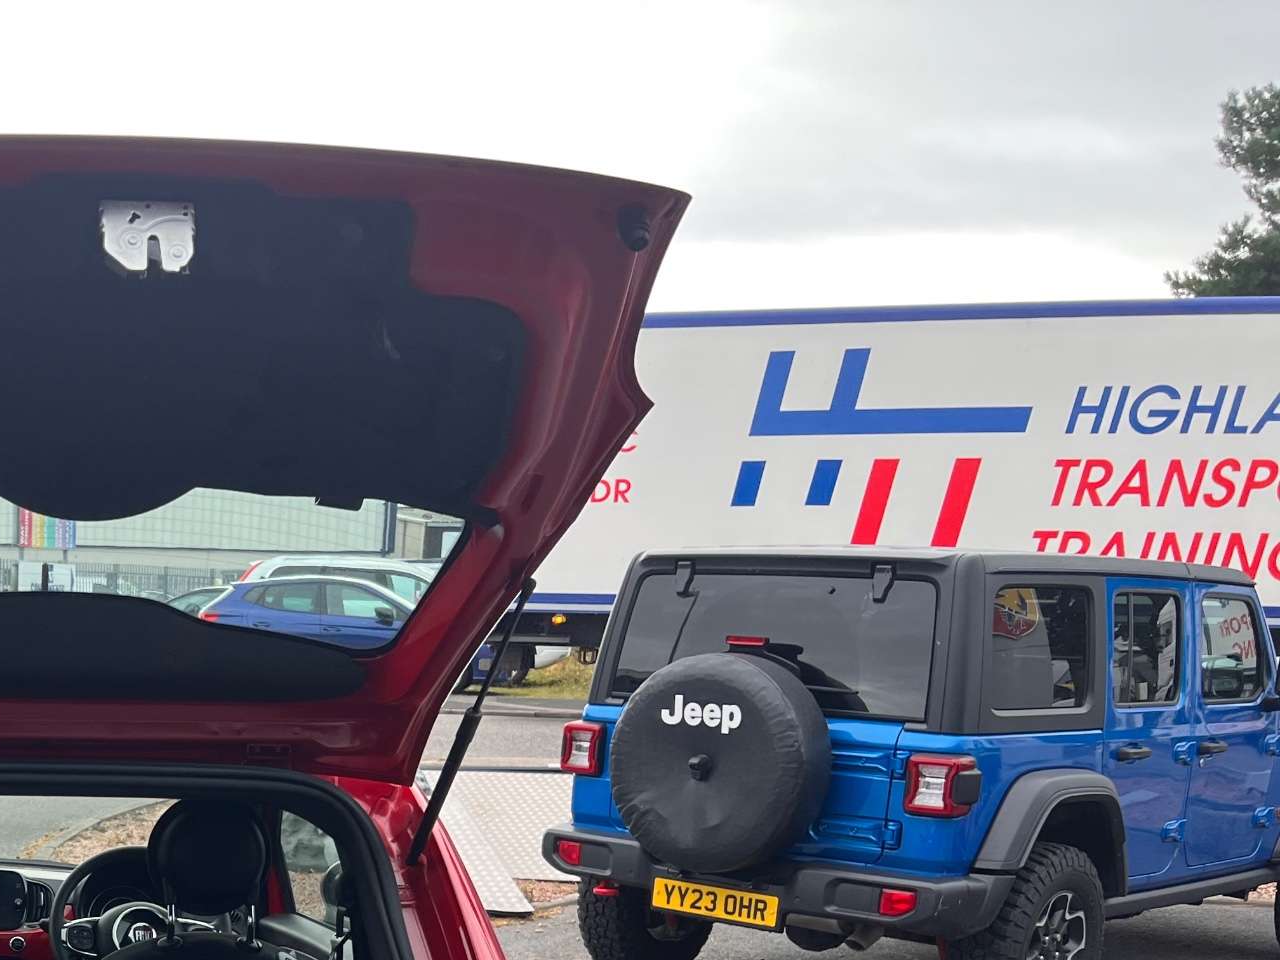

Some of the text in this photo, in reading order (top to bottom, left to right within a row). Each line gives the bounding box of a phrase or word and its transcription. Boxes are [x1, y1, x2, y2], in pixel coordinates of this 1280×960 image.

[1050, 458, 1280, 508] TRANSP
[1032, 530, 1280, 582] TRAININ
[661, 694, 742, 735] Jeep
[664, 883, 768, 922] YY23 OHR
